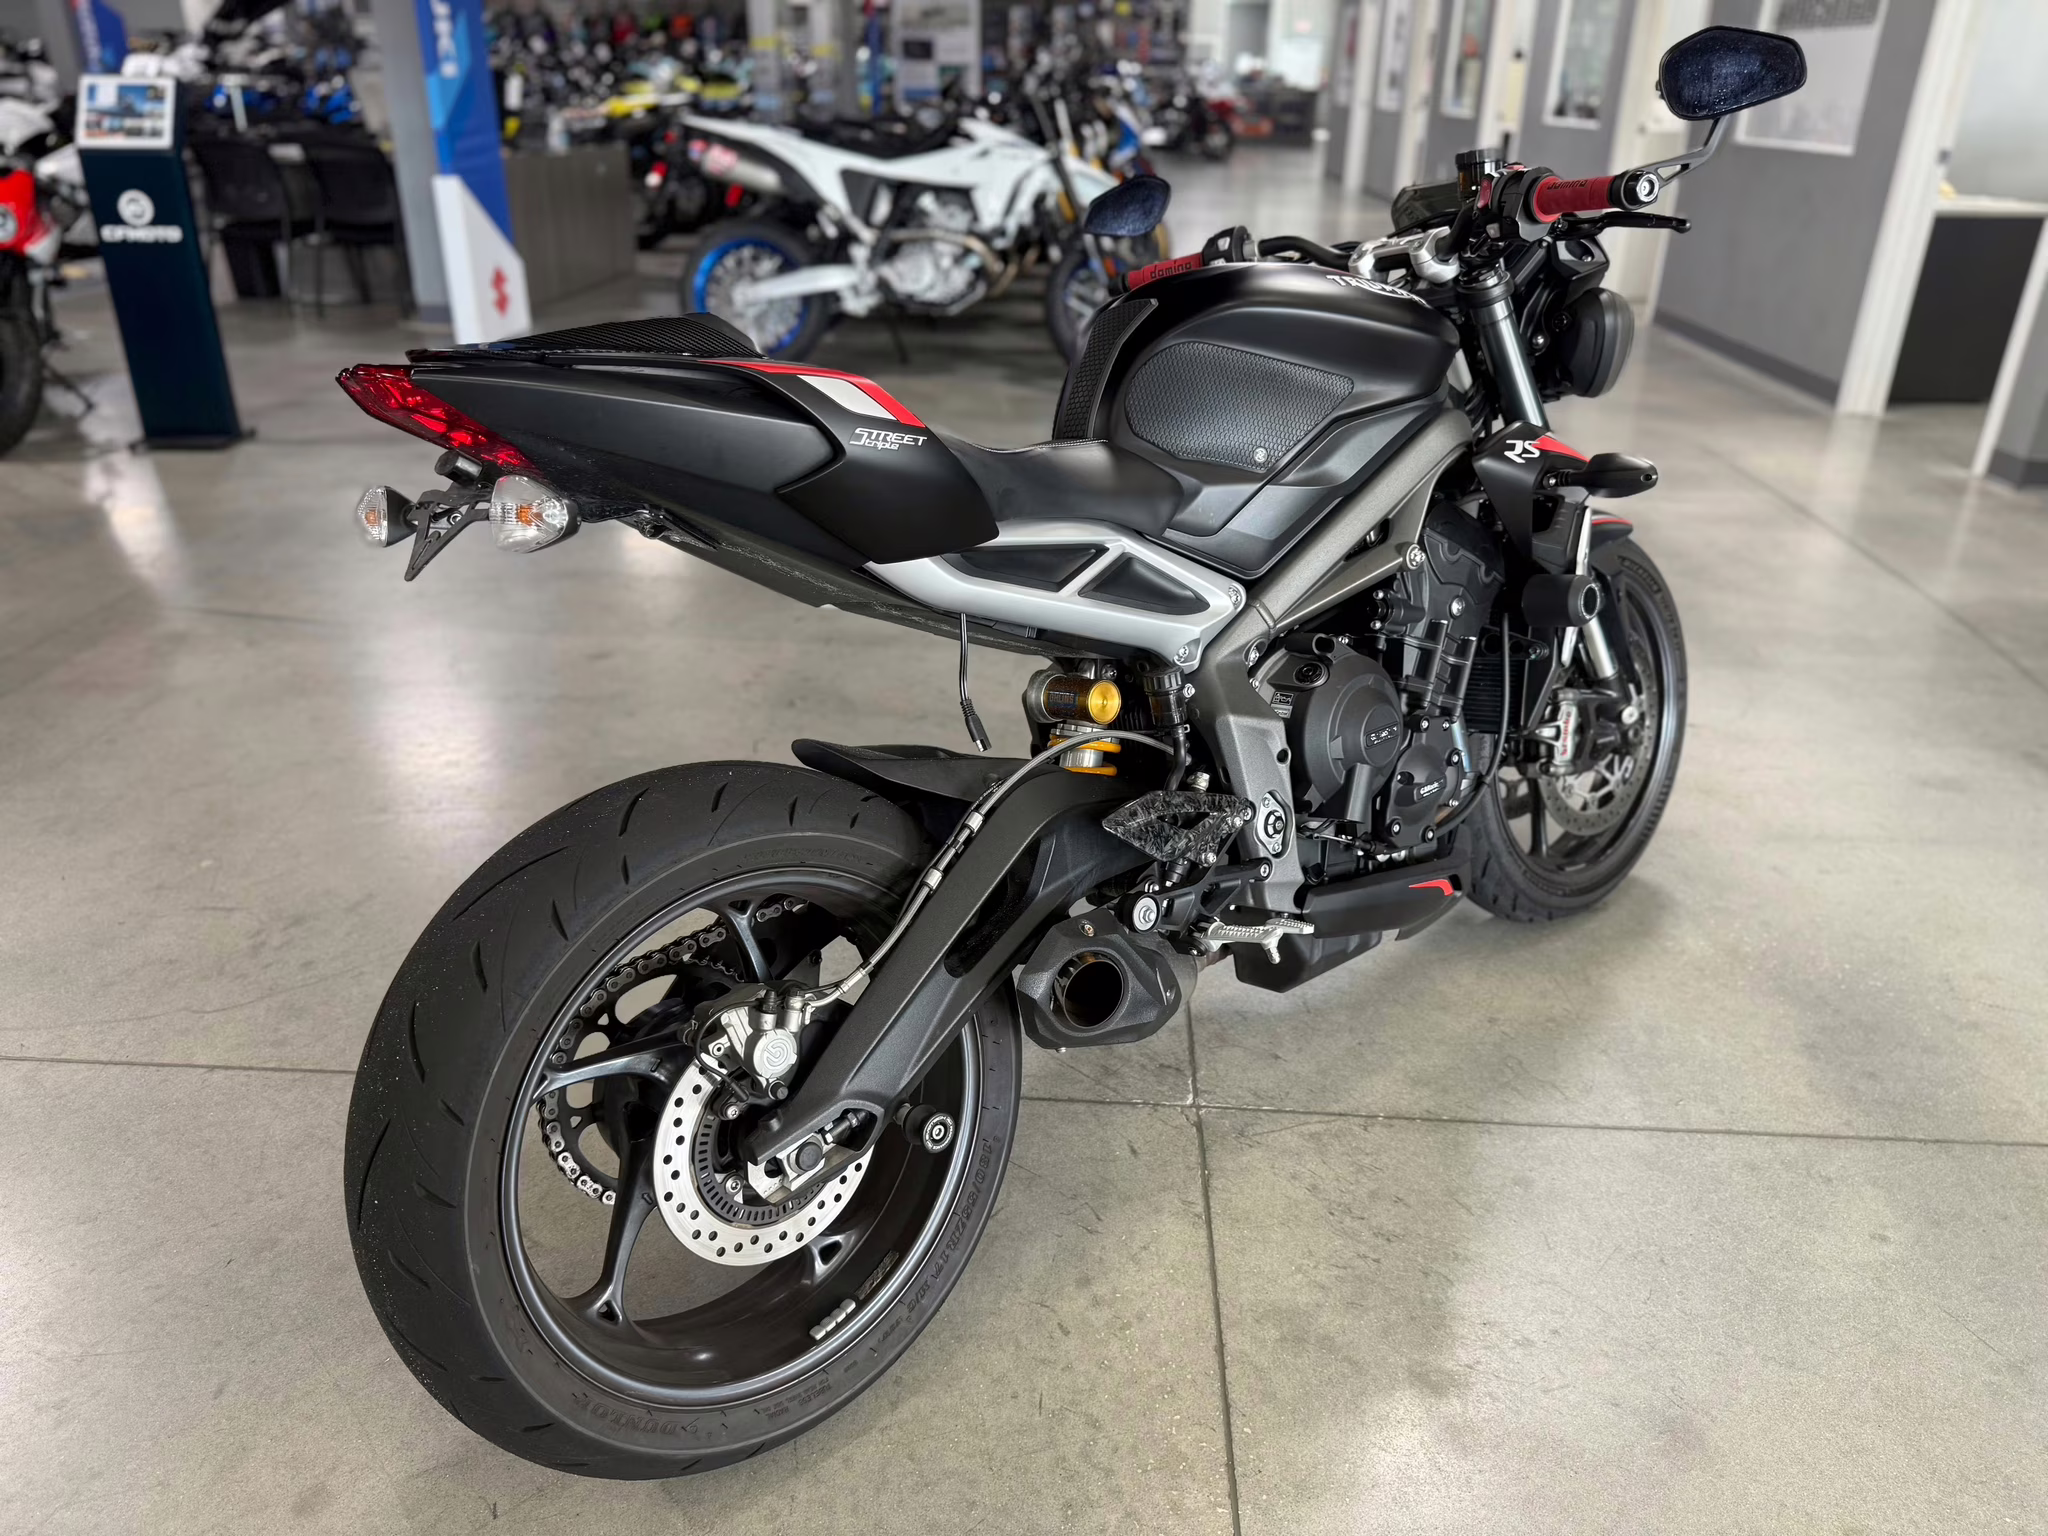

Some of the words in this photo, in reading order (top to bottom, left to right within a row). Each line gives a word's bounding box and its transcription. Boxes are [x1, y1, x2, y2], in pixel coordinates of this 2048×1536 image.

[1150, 260, 1192, 279] domino
[849, 428, 927, 446] STREET
[865, 439, 899, 450] triple
[1504, 440, 1541, 463] RS
